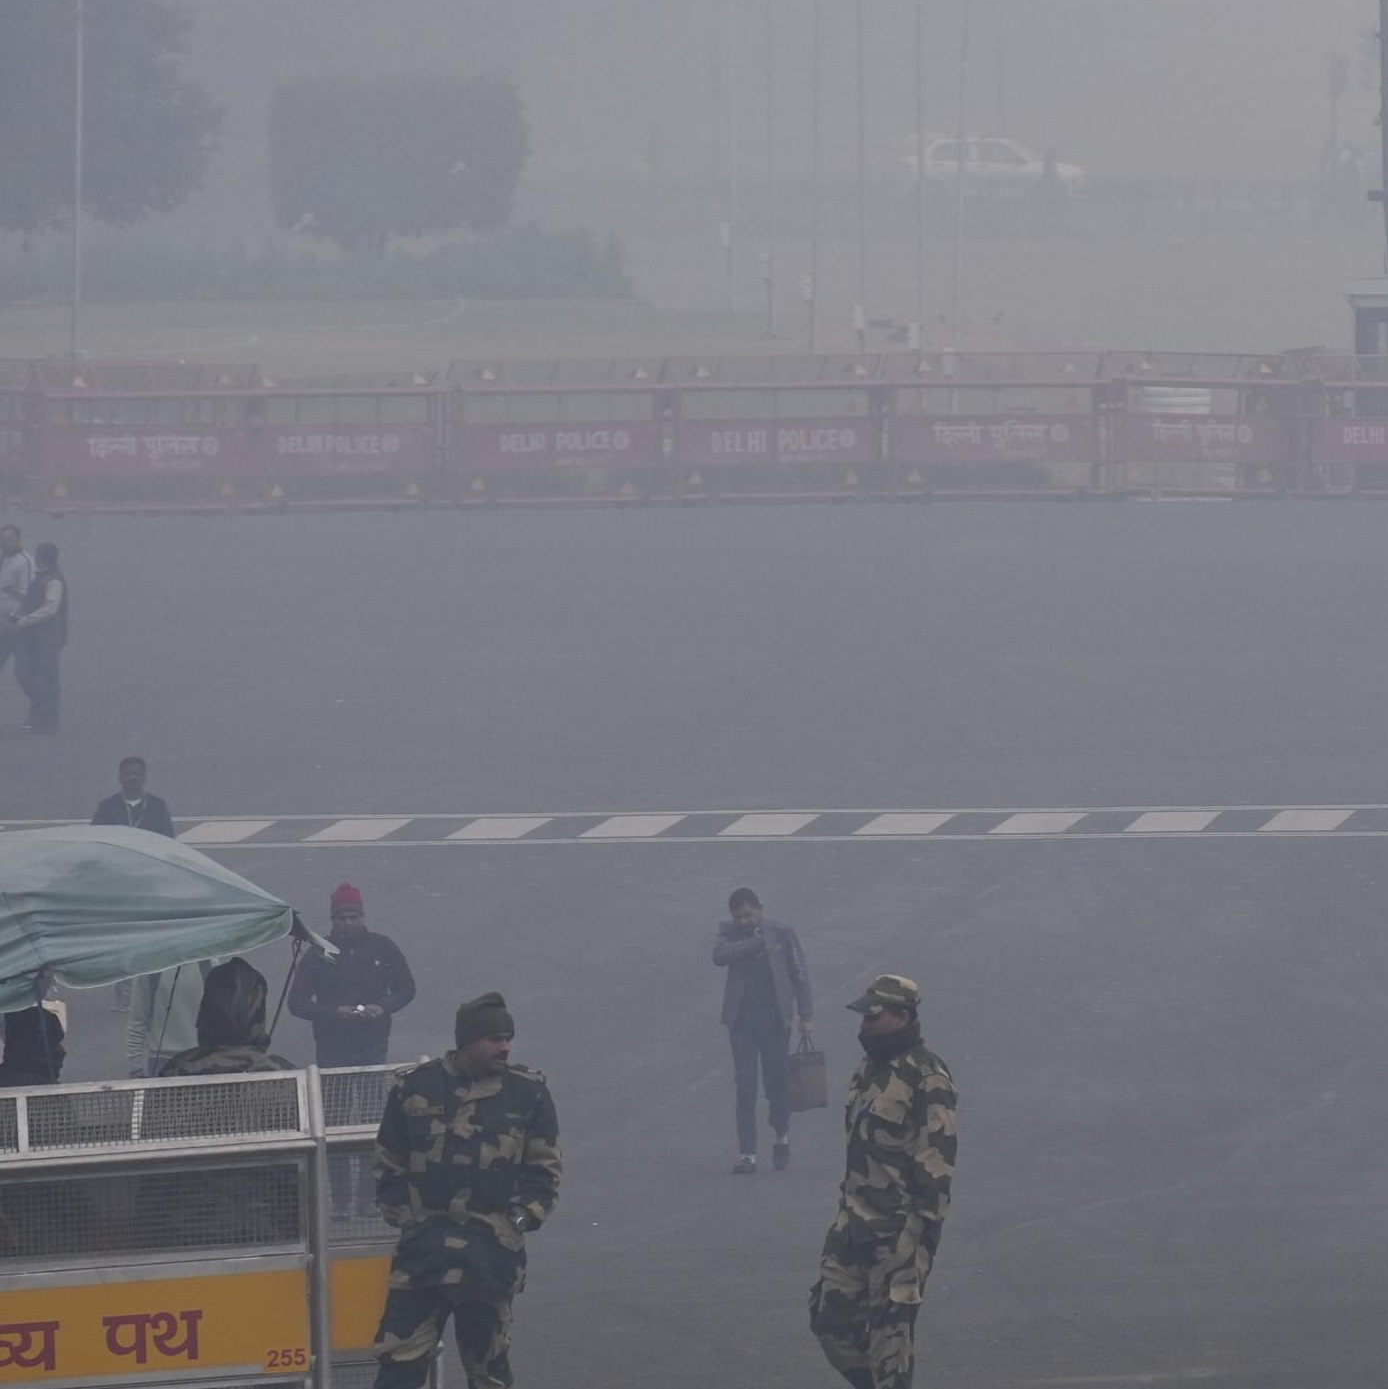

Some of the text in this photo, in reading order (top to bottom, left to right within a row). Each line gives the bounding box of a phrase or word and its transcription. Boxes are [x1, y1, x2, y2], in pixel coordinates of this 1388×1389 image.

[277, 434, 381, 454] DELHI POLICE
[501, 431, 611, 452] DELHI POLICE
[711, 429, 838, 453] DELHI POLICE
[1343, 426, 1384, 445] DELHI
[102, 1309, 202, 1364] पथ
[266, 1348, 306, 1368] 255
